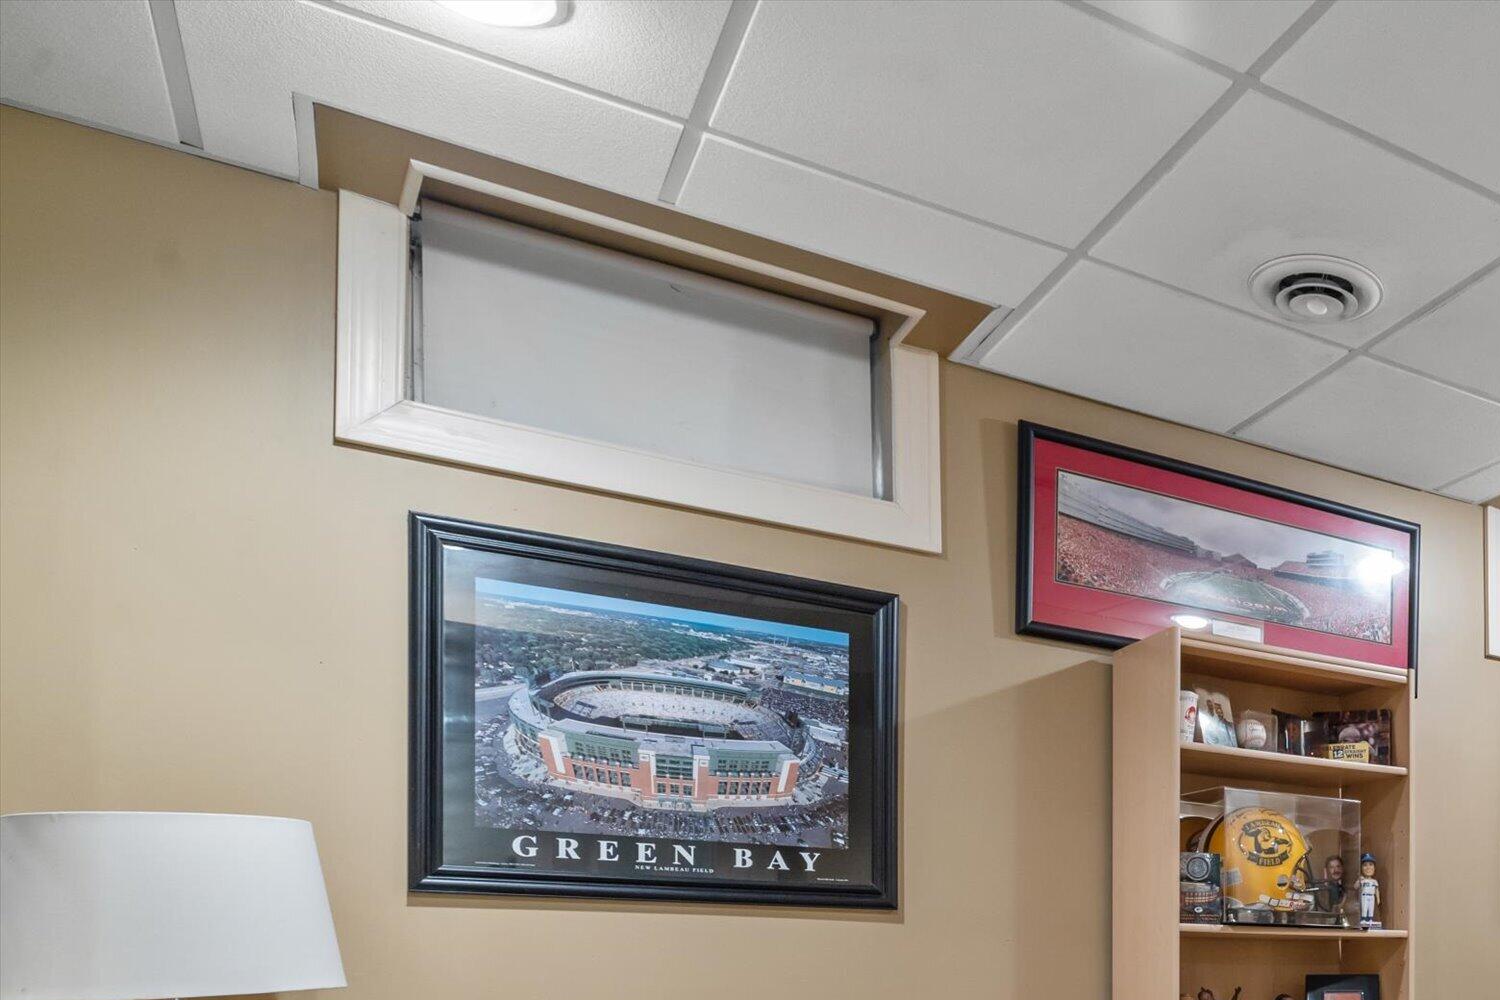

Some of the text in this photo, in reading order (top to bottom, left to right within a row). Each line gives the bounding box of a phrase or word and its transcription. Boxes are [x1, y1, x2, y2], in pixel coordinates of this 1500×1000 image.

[511, 835, 821, 872] GREEN BAY
[654, 865, 690, 873] LAMBEAU
